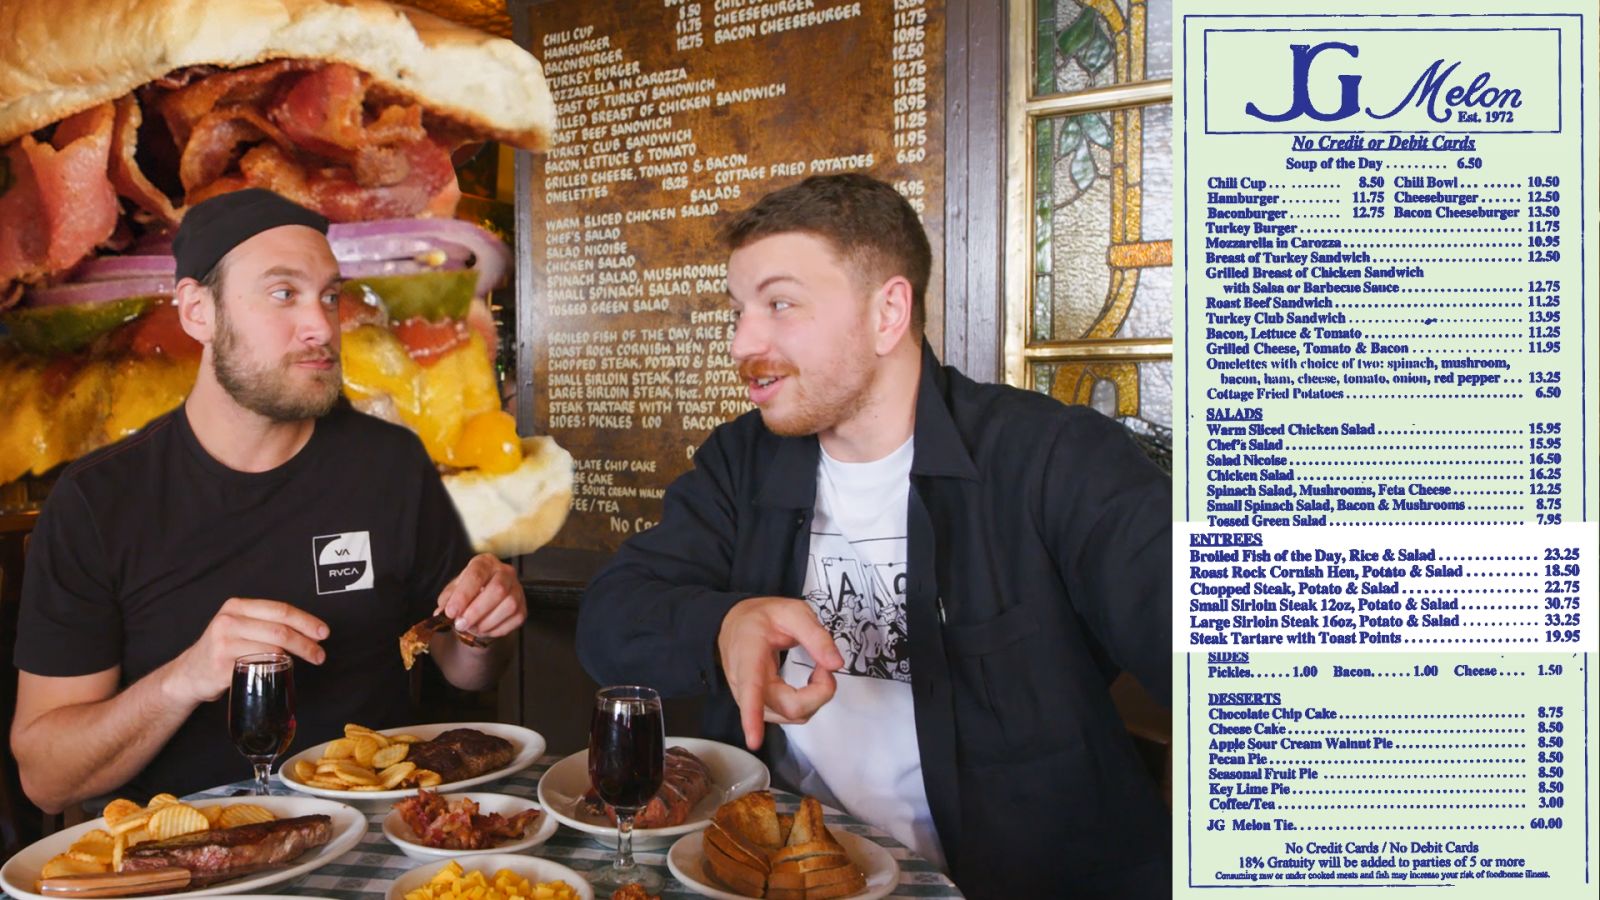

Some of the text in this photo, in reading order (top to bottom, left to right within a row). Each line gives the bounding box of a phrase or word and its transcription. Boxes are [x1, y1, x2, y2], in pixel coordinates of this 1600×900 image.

[714, 0, 815, 27] CHEESEBURGER
[714, 2, 861, 45] BACON CHEESEBURGER
[543, 25, 594, 47] CHILI CUP
[544, 36, 610, 60] HAMBURGER
[545, 48, 623, 75] BACONBURGER
[594, 61, 640, 81] BURGER
[619, 68, 687, 89] IN CAROZZA
[587, 79, 715, 111] OF TURKEY SANDWICH
[591, 83, 786, 123] BREAST OF CHICKEN SANDWICH
[582, 117, 672, 140] BEEF SANDWICH
[546, 129, 692, 159] TURKEY CLUB SANDWICH
[584, 152, 629, 170] LETTUCE
[634, 151, 644, 163] &
[648, 143, 696, 161] TOMATO
[545, 154, 748, 190] GRILLED CHEESE, TOMATO & BACON
[715, 153, 874, 184] COTTAGE FRIED POTATOES
[546, 186, 608, 204] OMELETTES
[691, 185, 740, 202] SALADS
[546, 203, 719, 232] WARM SLICED CHICKEN SALAD
[585, 228, 620, 242] SALAD
[547, 246, 580, 259] SALAD
[546, 255, 635, 273] CHICKEN SALAD
[547, 273, 594, 289] SPINACH
[593, 329, 618, 343] FISH
[622, 329, 636, 341] OF
[641, 328, 663, 341] THE
[696, 326, 722, 340] RICE
[549, 359, 596, 371] CHOPPED
[645, 356, 690, 368] POTATO
[549, 386, 629, 399] LARGE SIRLOIN
[549, 401, 715, 413] STEAK TARTARE WITH TOAST
[589, 416, 632, 428] PICKLES
[605, 460, 656, 472] CHIP CAKE
[588, 473, 613, 485] CAKE
[582, 485, 605, 495] SOUR
[608, 486, 637, 497] CREAM
[610, 516, 629, 533] No
[329, 568, 359, 577] RVCA
